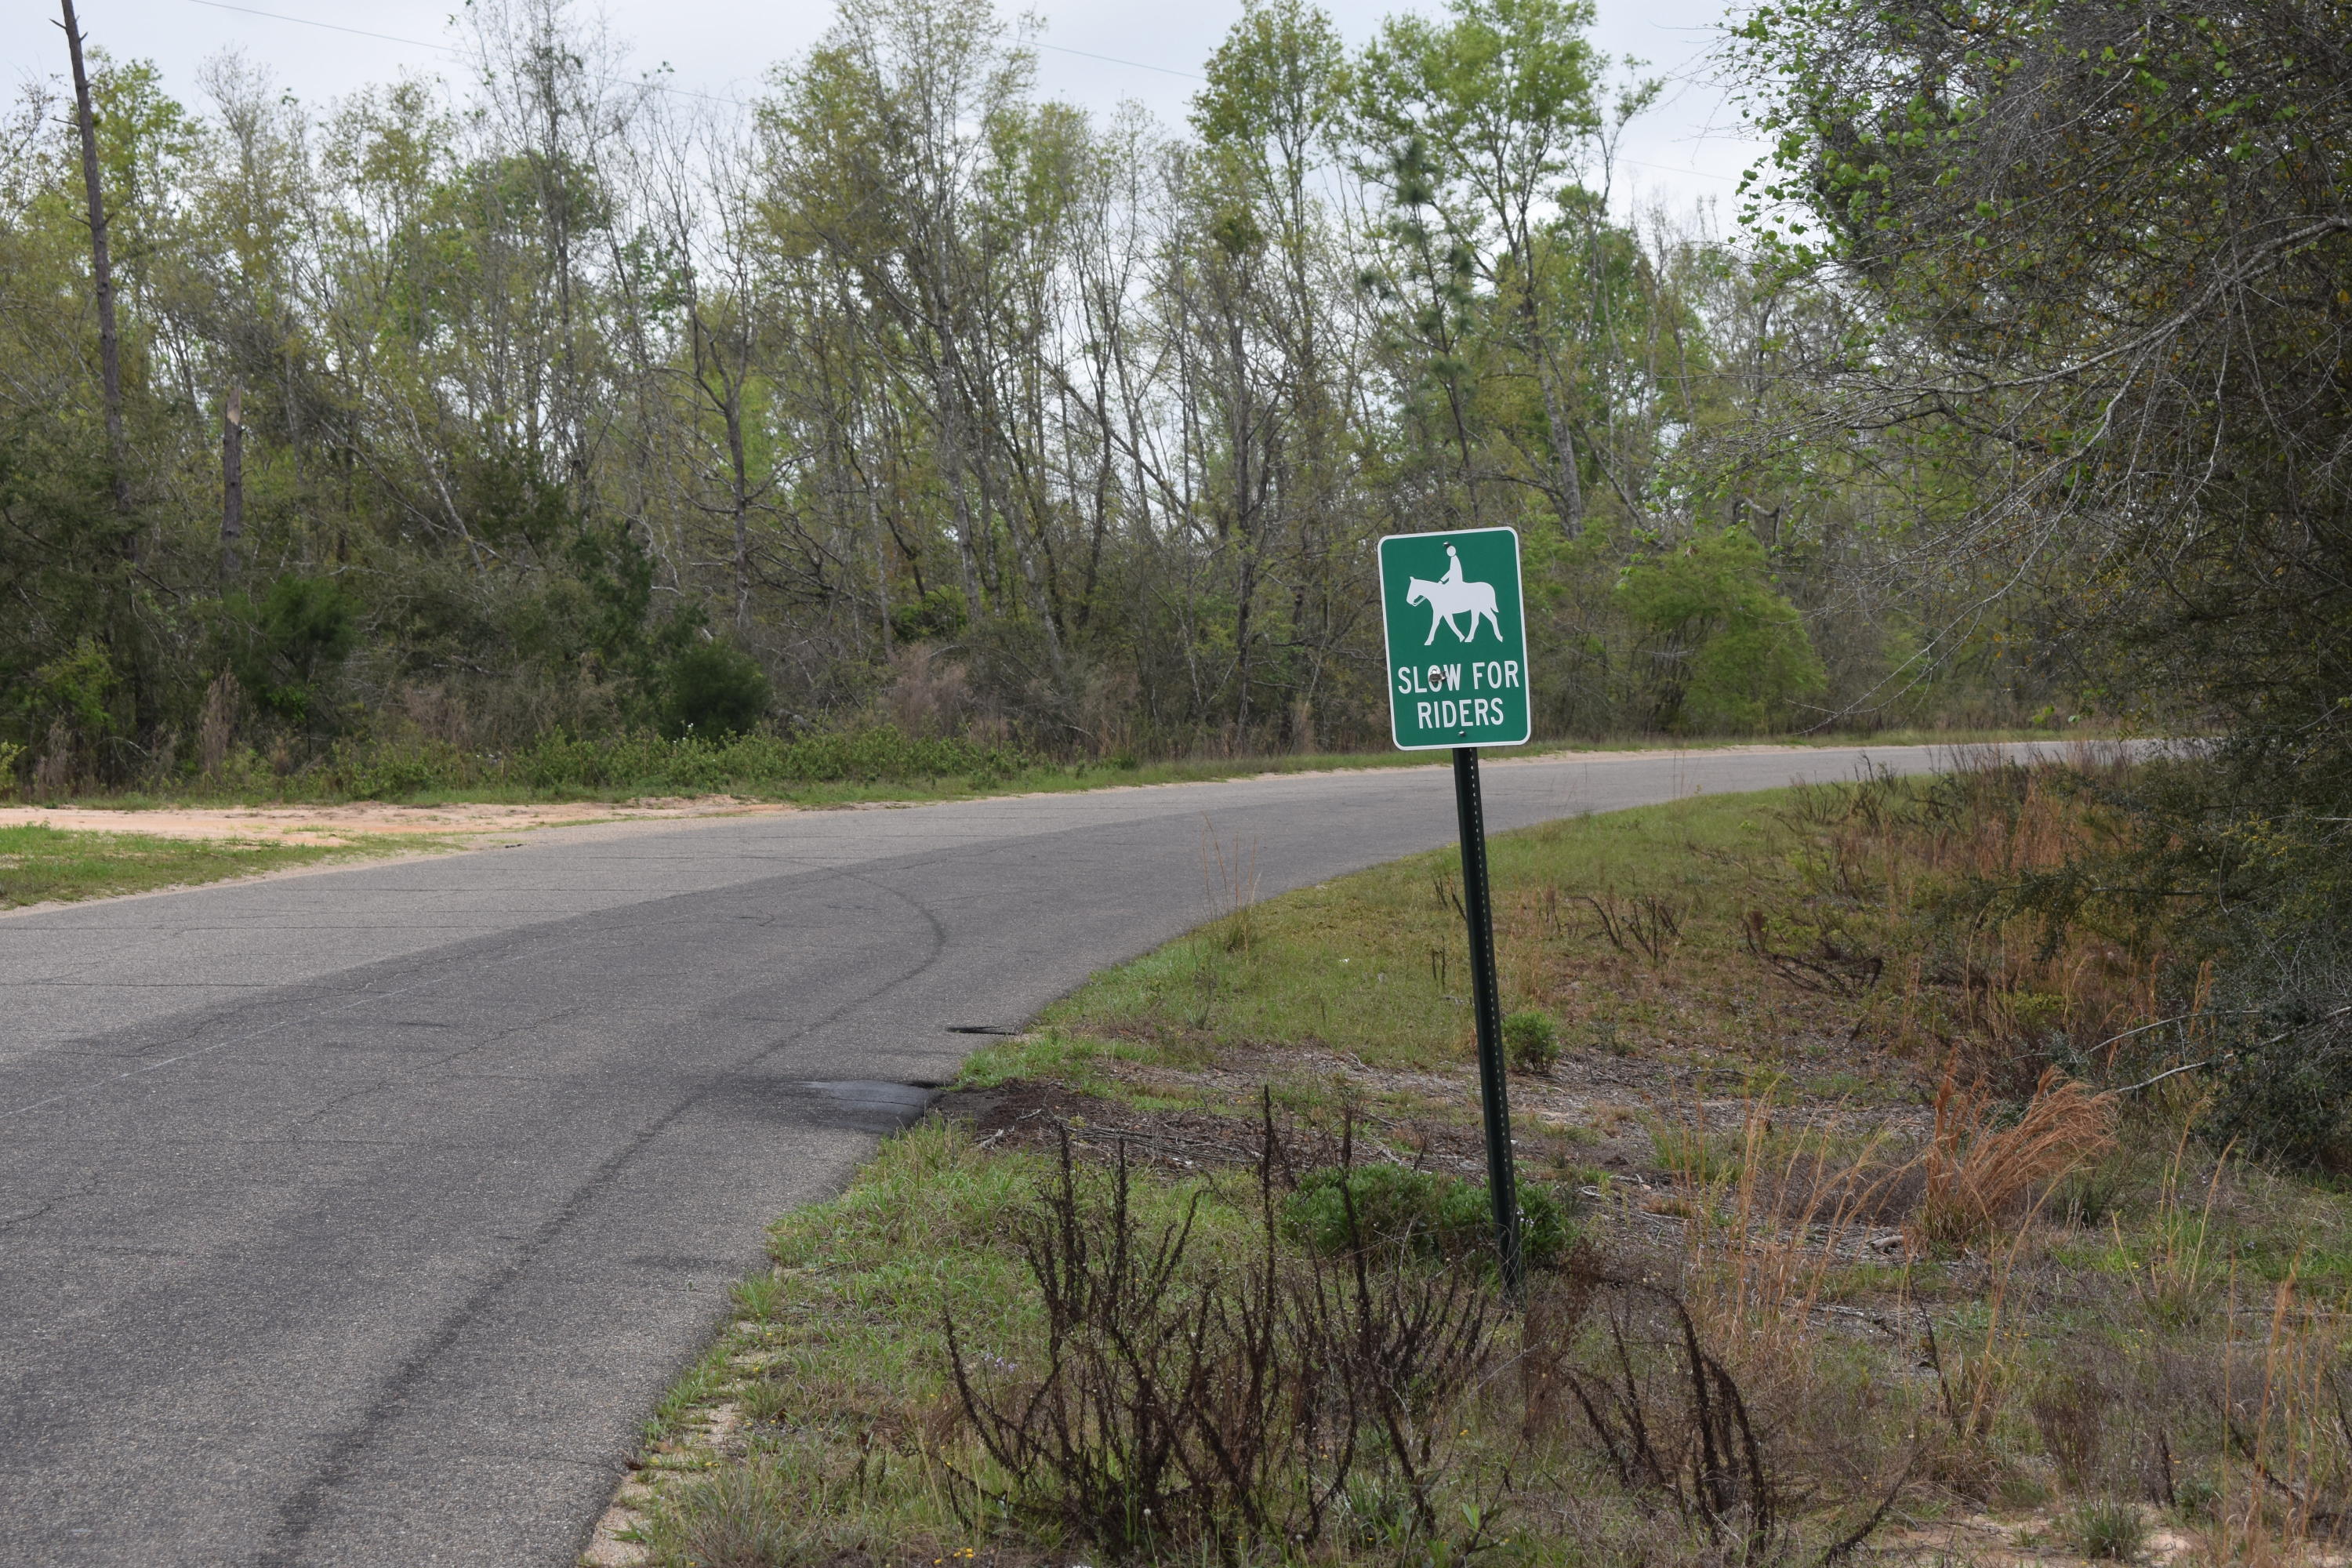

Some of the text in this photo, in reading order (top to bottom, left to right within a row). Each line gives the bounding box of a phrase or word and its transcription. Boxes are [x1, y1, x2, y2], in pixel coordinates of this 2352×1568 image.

[1398, 661, 1519, 694] SLOW FOR
[1417, 698, 1504, 729] RIDERS
